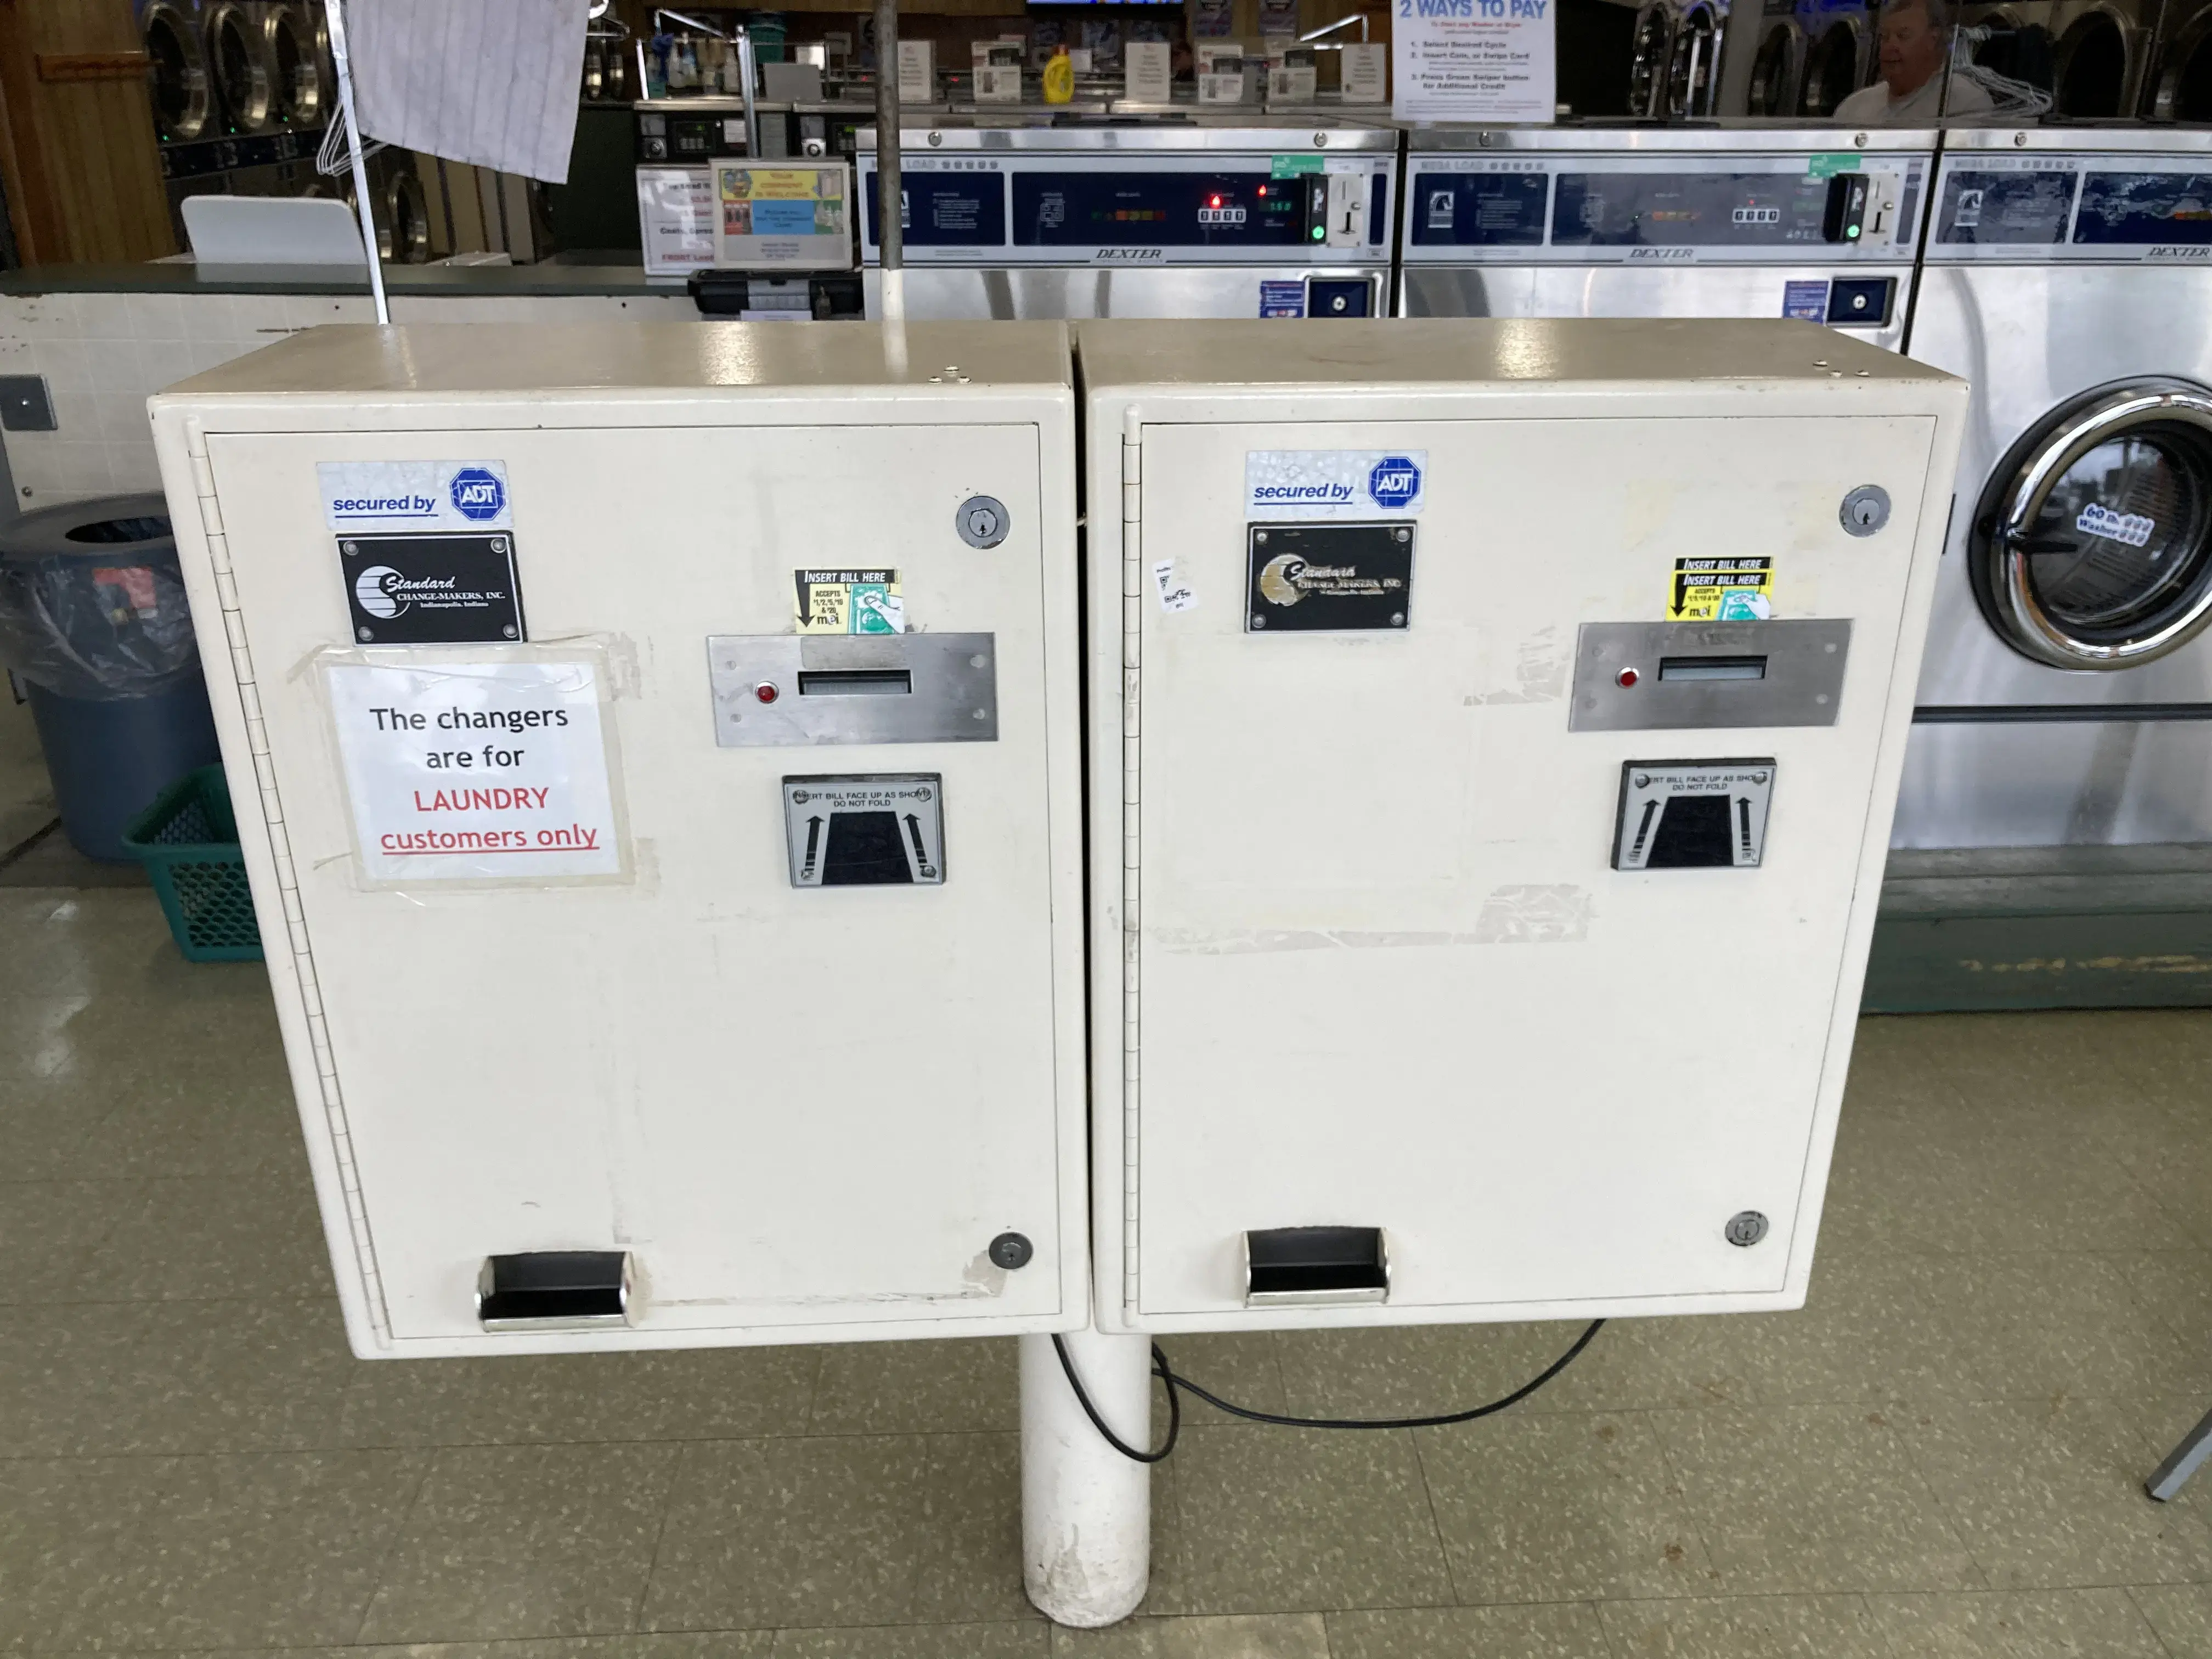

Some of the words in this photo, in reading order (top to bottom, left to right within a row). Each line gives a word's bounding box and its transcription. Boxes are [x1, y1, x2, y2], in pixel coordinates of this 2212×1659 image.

[1400, 0, 1411, 18] 2
[1418, 0, 1472, 17] WAYS
[1478, 0, 1504, 16] TO
[1510, 1, 1547, 19] PAY
[1097, 249, 1163, 258] DEXTER
[1629, 249, 1694, 258] DEXTER
[2147, 246, 2211, 257] DEXTER
[1377, 473, 1412, 492] ADT
[461, 485, 496, 504] ADT
[1254, 483, 1329, 499] secured
[1331, 483, 1353, 500] by
[333, 496, 409, 511] secured
[414, 494, 436, 512] by
[1683, 558, 1716, 570] INSERT
[1717, 559, 1735, 569] BILL
[1738, 559, 1762, 569] HERE
[385, 575, 455, 592] Standard
[804, 570, 837, 583] INSERT
[840, 572, 859, 583] BILL
[862, 572, 886, 583] HERE
[1683, 574, 1716, 585] INSERT
[1717, 574, 1735, 585] BILL
[1737, 574, 1761, 585] HERE
[396, 592, 484, 602] CHANGE-MAKERS,
[486, 591, 506, 600] INC.
[369, 707, 426, 731] The
[437, 706, 569, 733] changers
[427, 749, 473, 769] are
[483, 744, 525, 768] for
[1706, 782, 1728, 791] FOLD
[414, 787, 550, 812] LAUNDRY
[381, 829, 527, 850] customers
[537, 823, 599, 850] only
